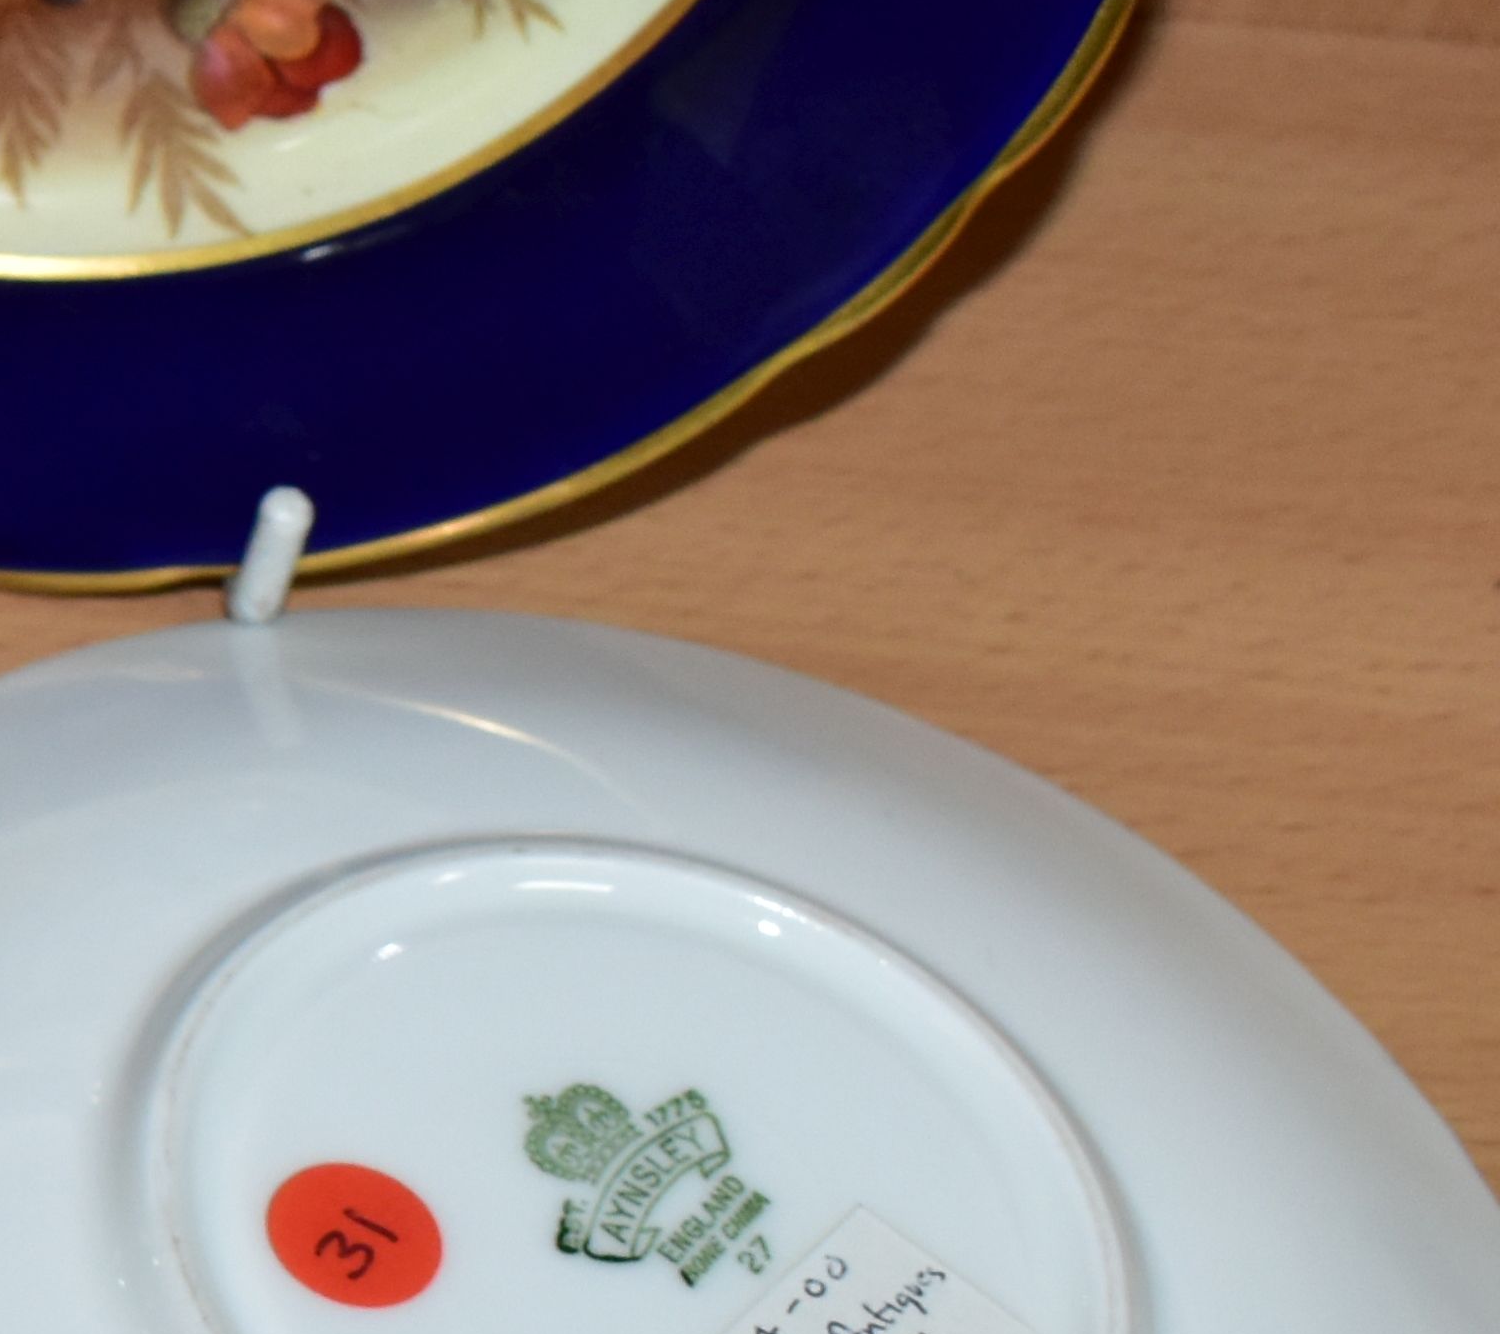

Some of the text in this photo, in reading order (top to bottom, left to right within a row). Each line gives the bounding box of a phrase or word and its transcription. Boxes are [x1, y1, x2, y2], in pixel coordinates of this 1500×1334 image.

[600, 1125, 705, 1245] AYNSLEY
[656, 1174, 745, 1264] ENGLAND
[314, 1207, 399, 1281] 31
[736, 1234, 771, 1275] 27
